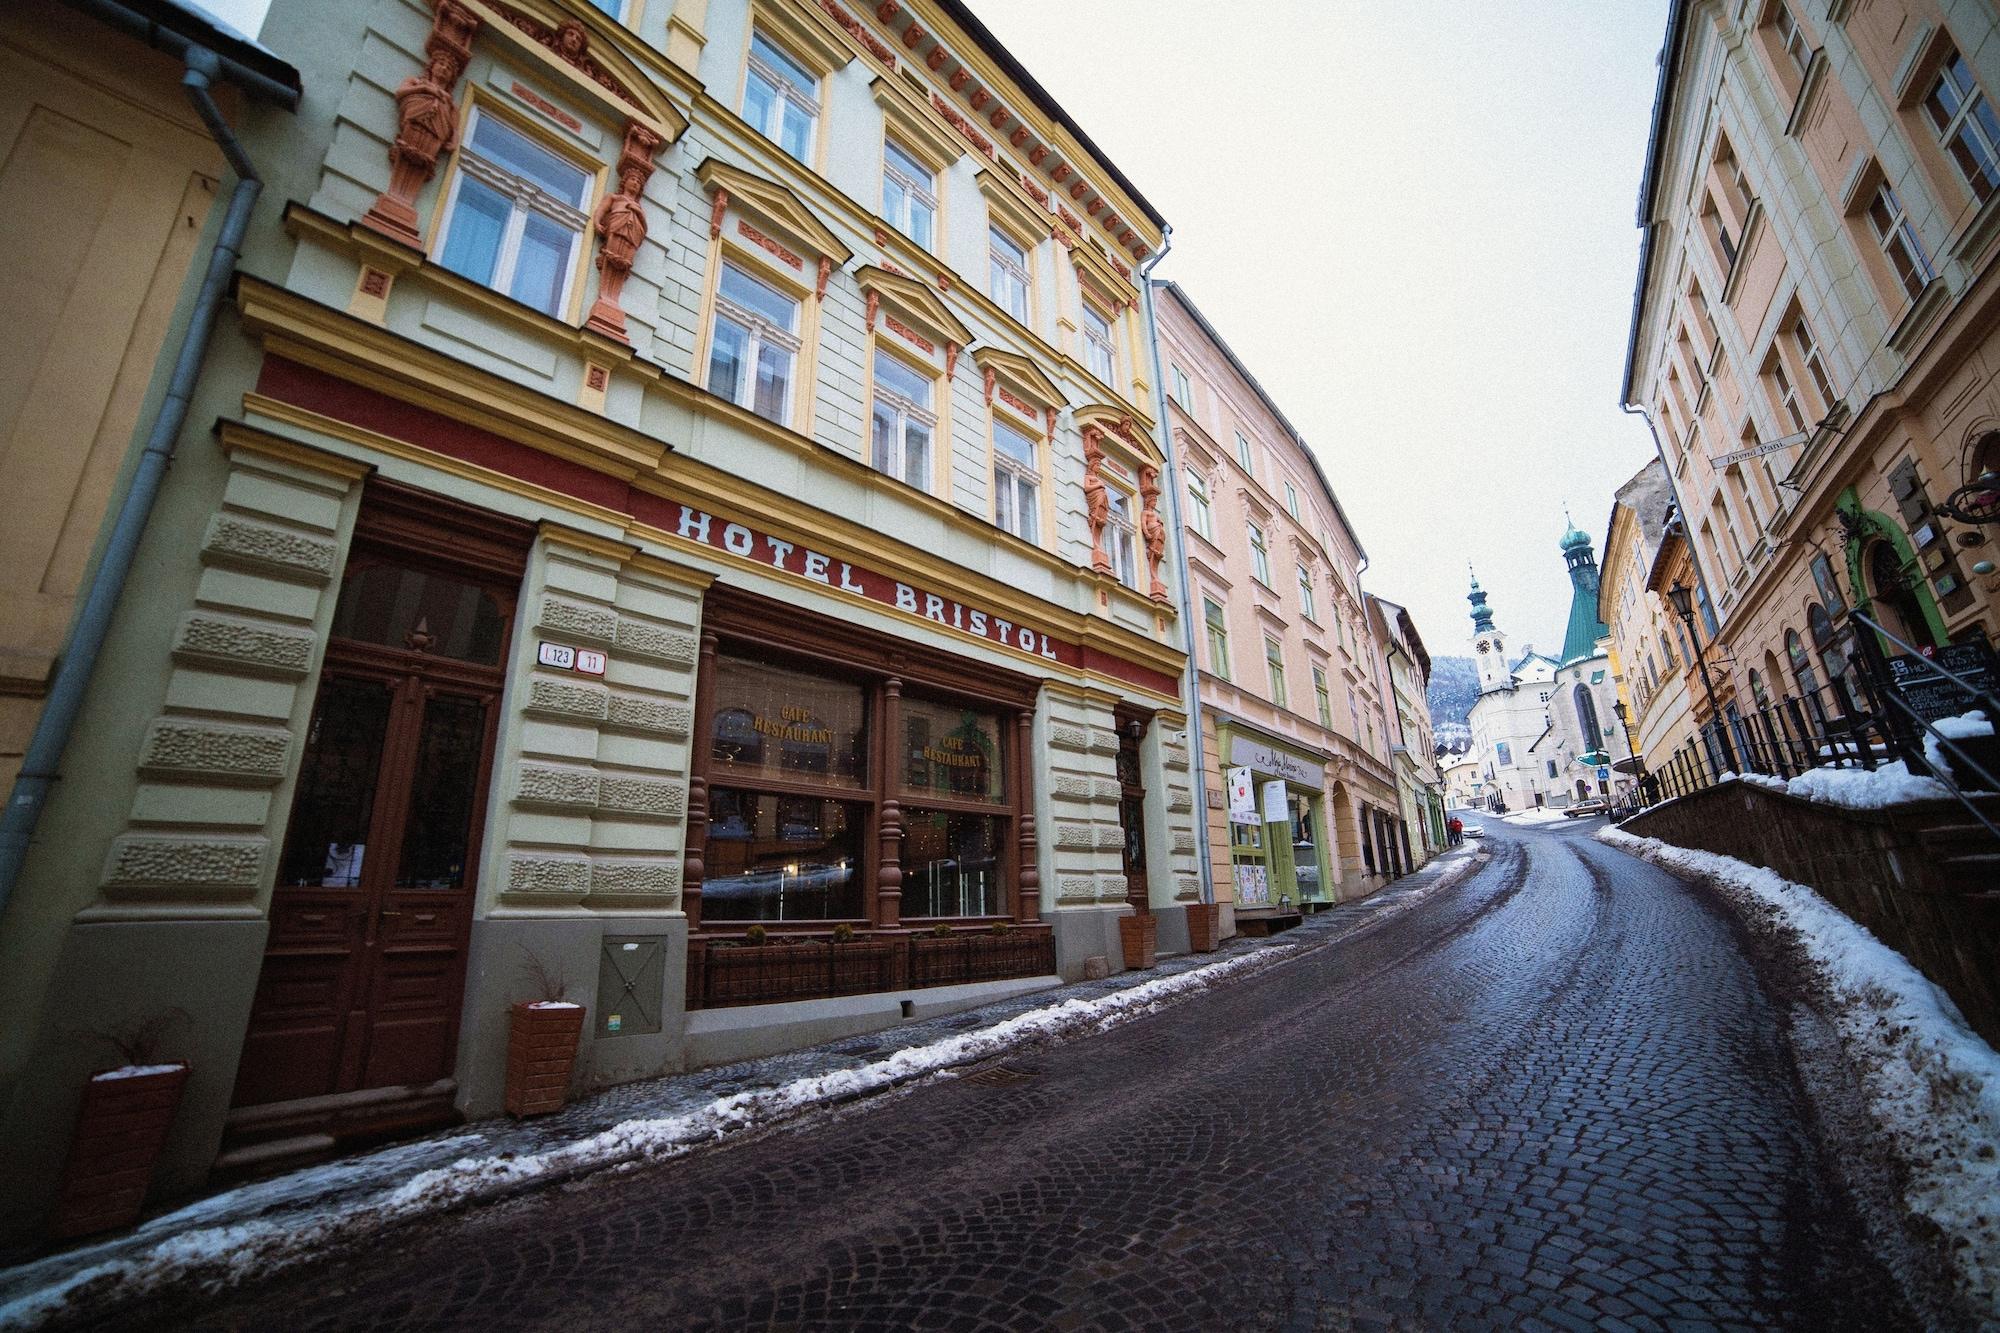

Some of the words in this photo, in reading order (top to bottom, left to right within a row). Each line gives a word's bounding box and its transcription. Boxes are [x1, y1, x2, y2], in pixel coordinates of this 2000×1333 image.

[677, 505, 864, 595] HOTEL
[895, 582, 1057, 660] BRISTOL
[587, 655, 597, 669] 11
[754, 715, 833, 743] RESTAURANT
[923, 745, 980, 767] RESTAURANT
